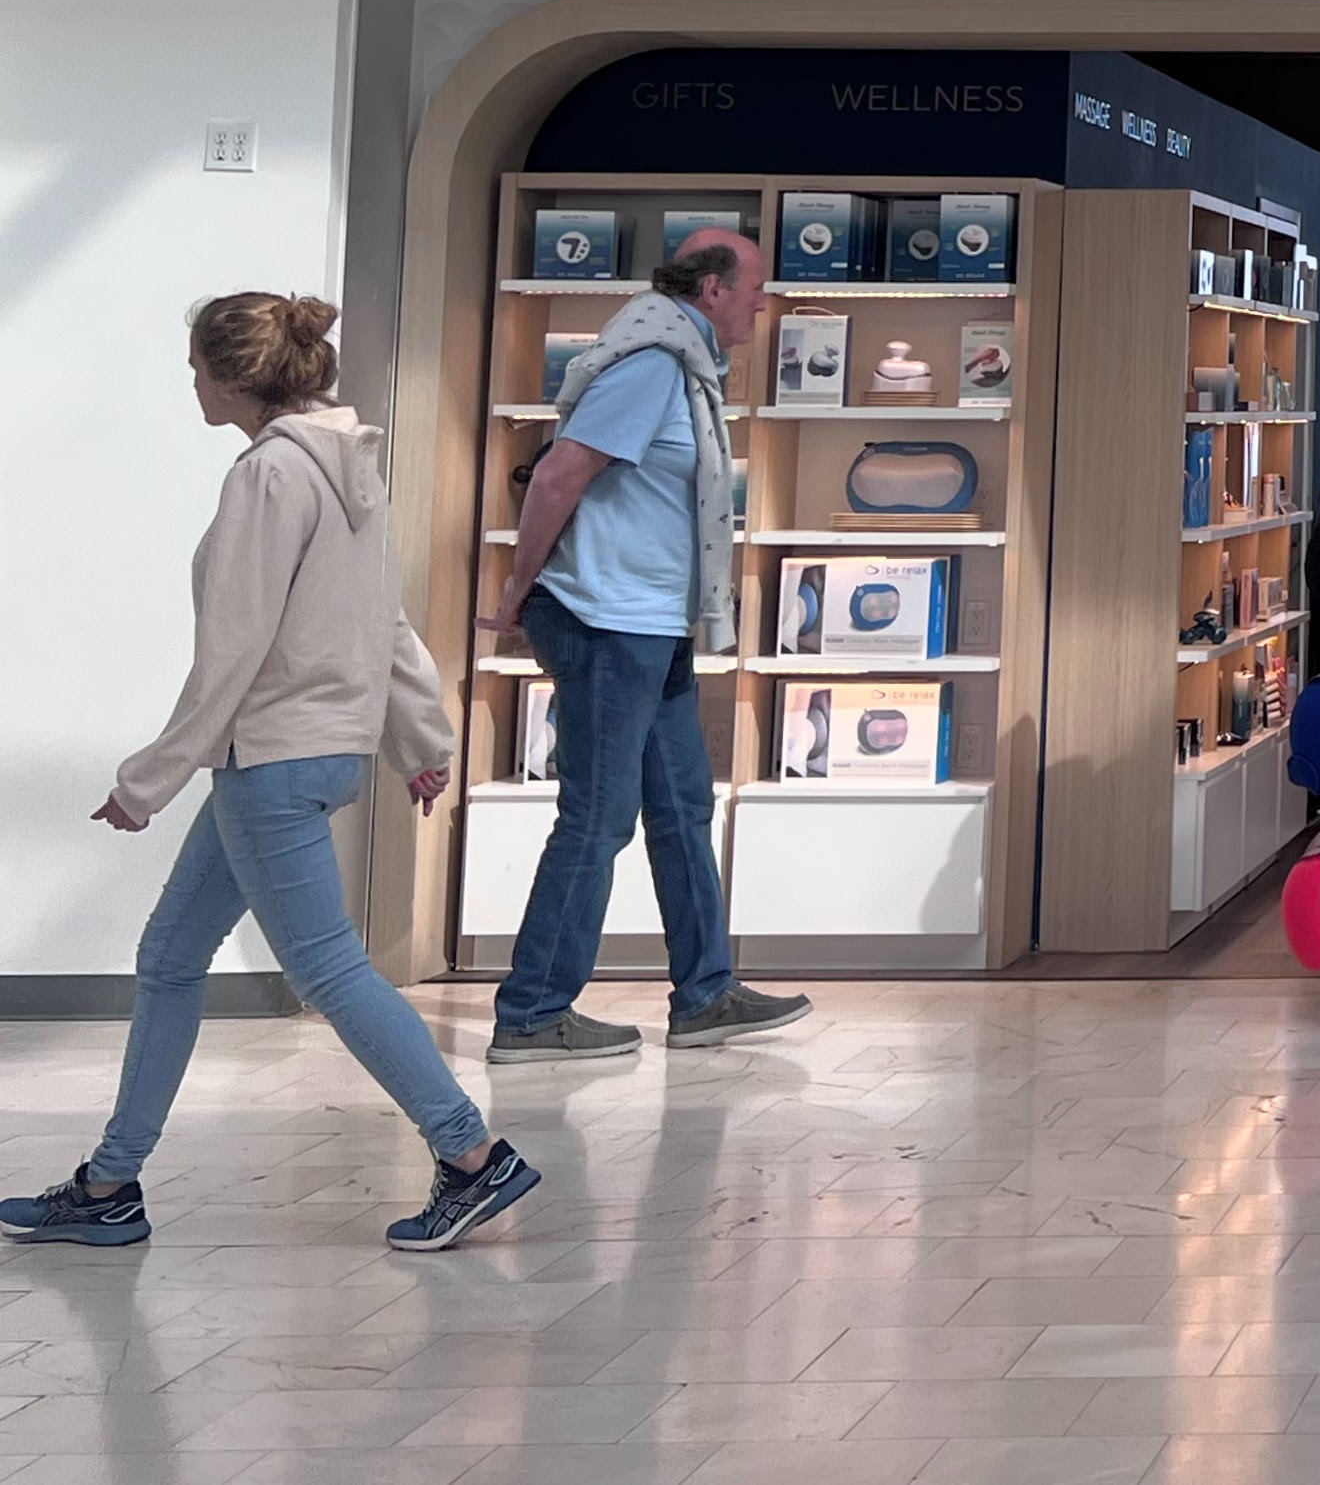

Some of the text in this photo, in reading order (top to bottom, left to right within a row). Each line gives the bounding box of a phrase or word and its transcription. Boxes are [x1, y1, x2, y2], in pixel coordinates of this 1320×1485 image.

[631, 81, 735, 110] GIFTS
[830, 82, 1025, 113] WELLNESS
[1074, 91, 1112, 130] MASSAGE
[886, 565, 927, 575] be relax
